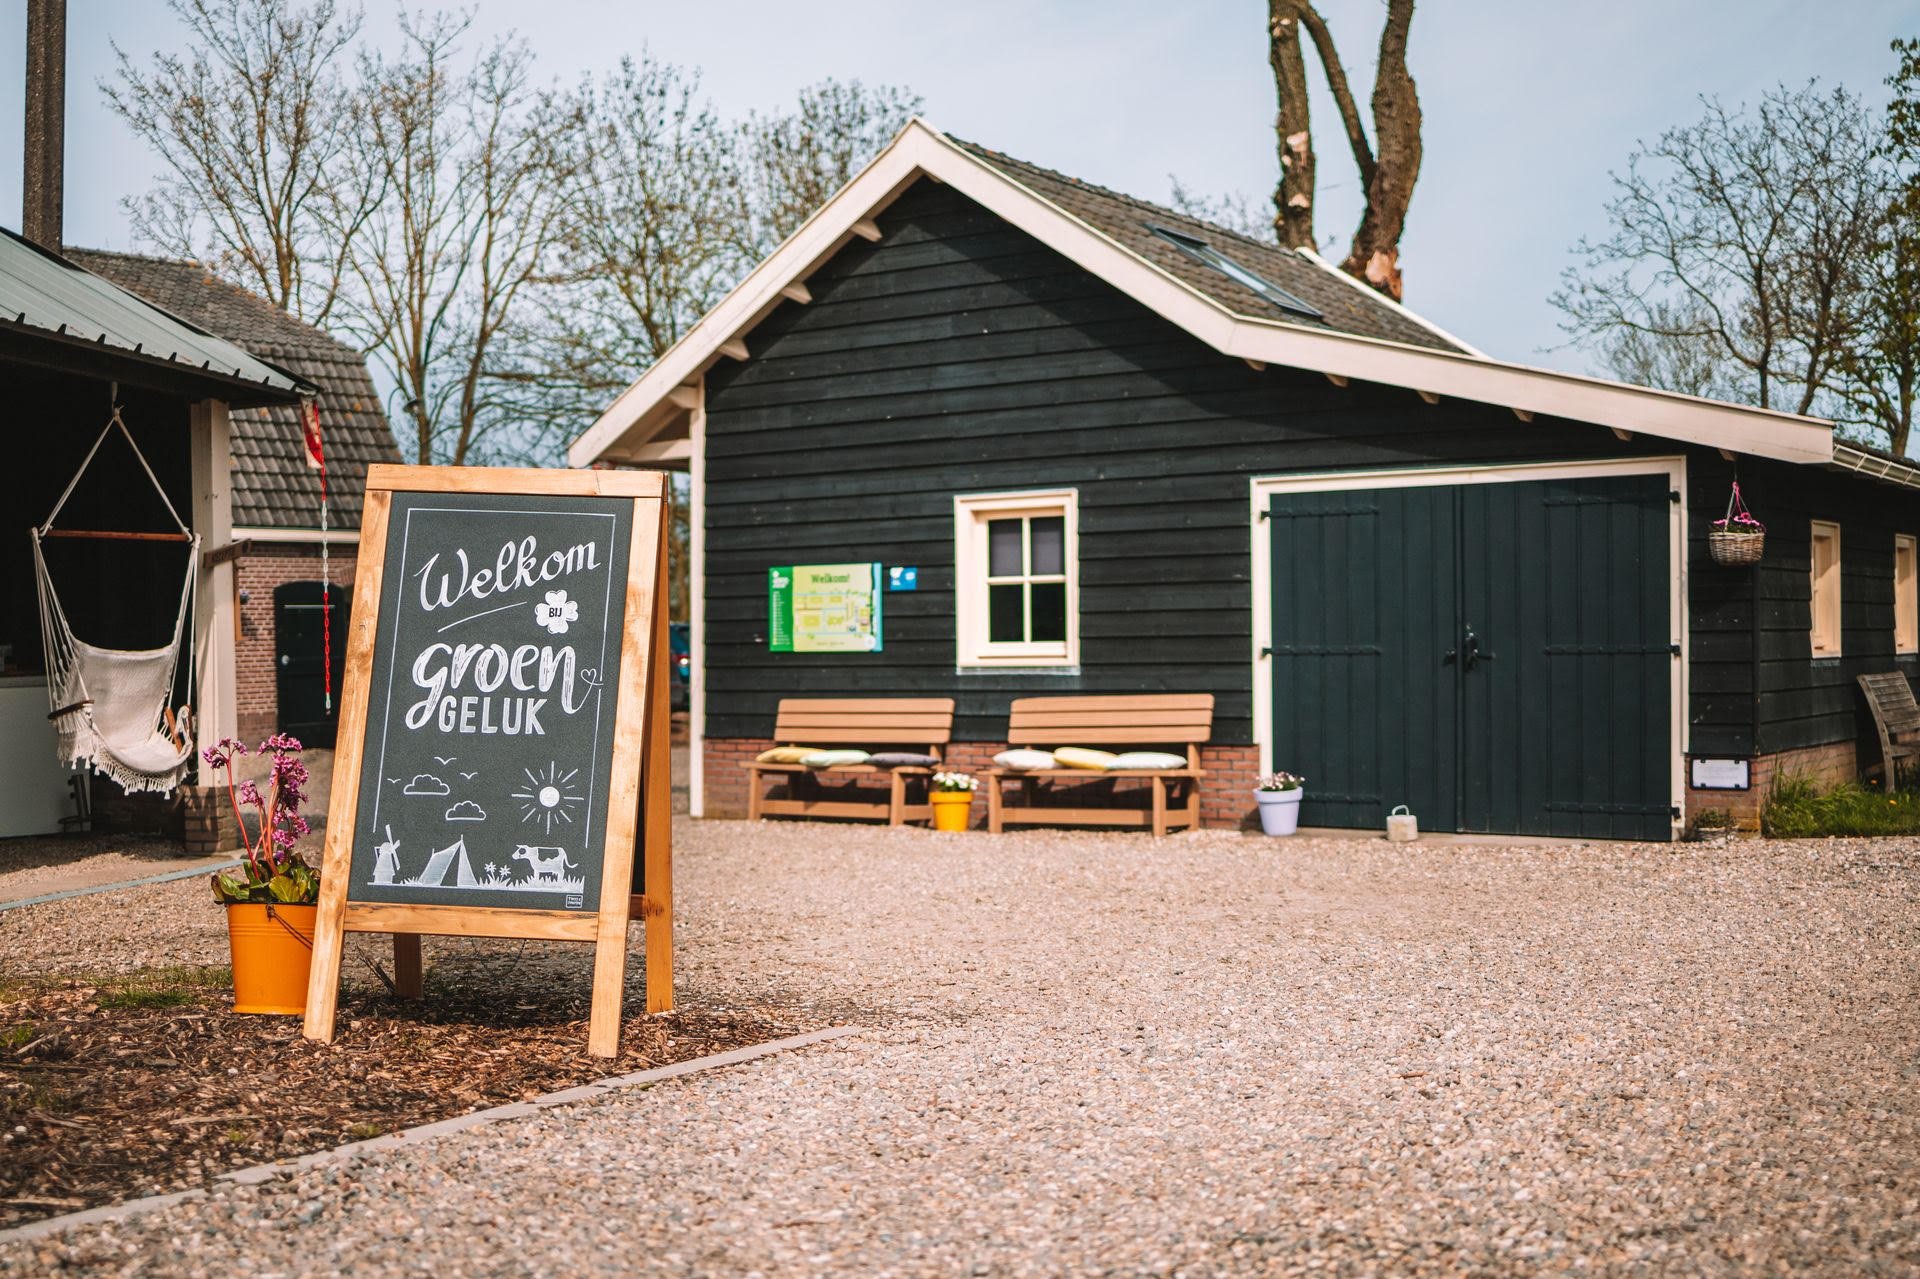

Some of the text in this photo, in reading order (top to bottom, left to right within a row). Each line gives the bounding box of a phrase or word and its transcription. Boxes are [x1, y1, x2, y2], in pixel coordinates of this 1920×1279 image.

[414, 535, 601, 611] Welkom
[811, 573, 850, 584] Welkom!
[549, 607, 563, 618] BIJ
[405, 642, 579, 730] groen
[438, 695, 548, 735] GELUK
